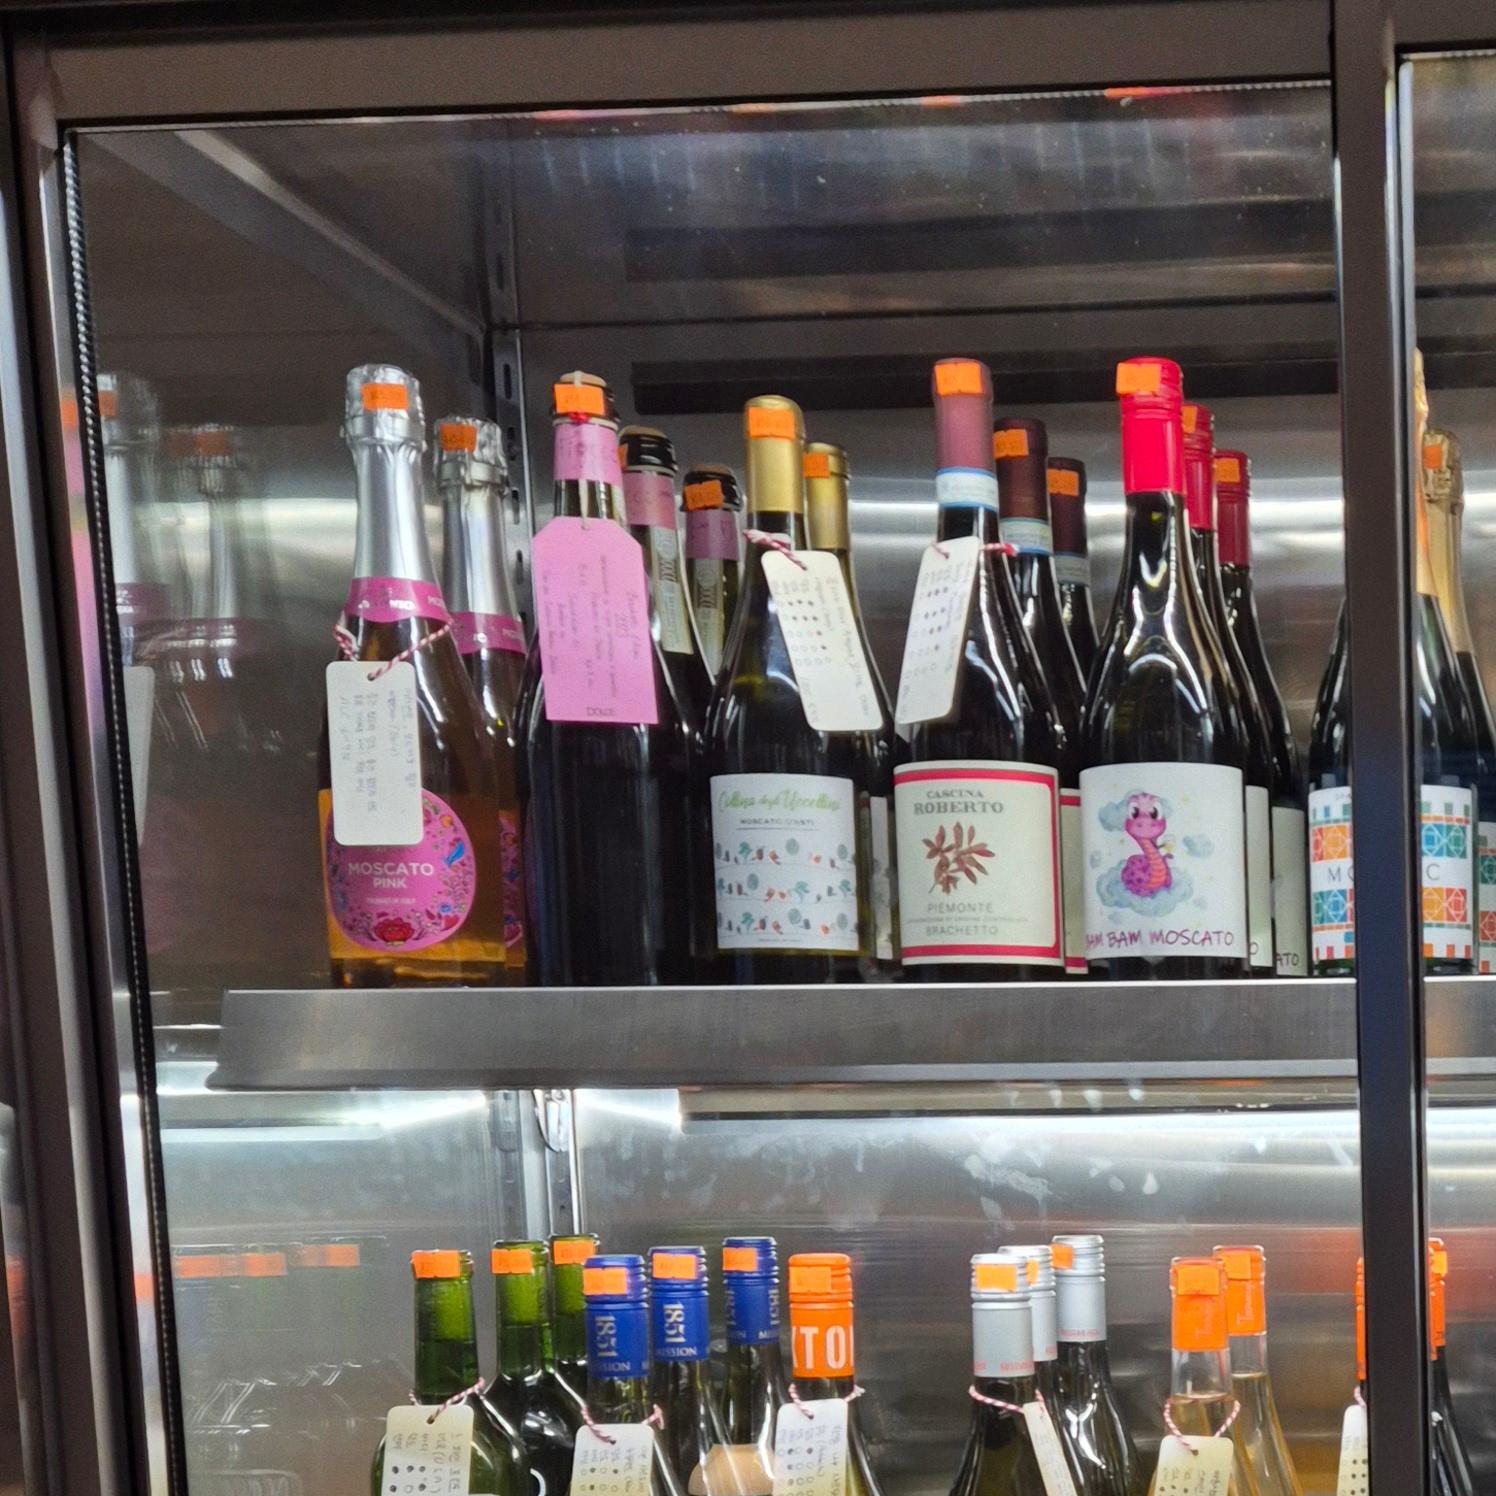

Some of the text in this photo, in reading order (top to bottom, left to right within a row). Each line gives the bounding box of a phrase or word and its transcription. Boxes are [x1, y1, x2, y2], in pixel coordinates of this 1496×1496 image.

[926, 788, 984, 800] CASCINA
[913, 800, 1004, 816] ROBERTO
[348, 861, 435, 877] MOSCATO
[372, 877, 408, 889] PINK
[927, 902, 994, 914] PIEMONTE
[925, 925, 999, 936] BRACHETTO
[1108, 930, 1142, 949] BAM
[1149, 929, 1235, 947] MOSCATO
[662, 1301, 687, 1344] 1851
[595, 1311, 618, 1358] 1851
[793, 1325, 854, 1371] TO
